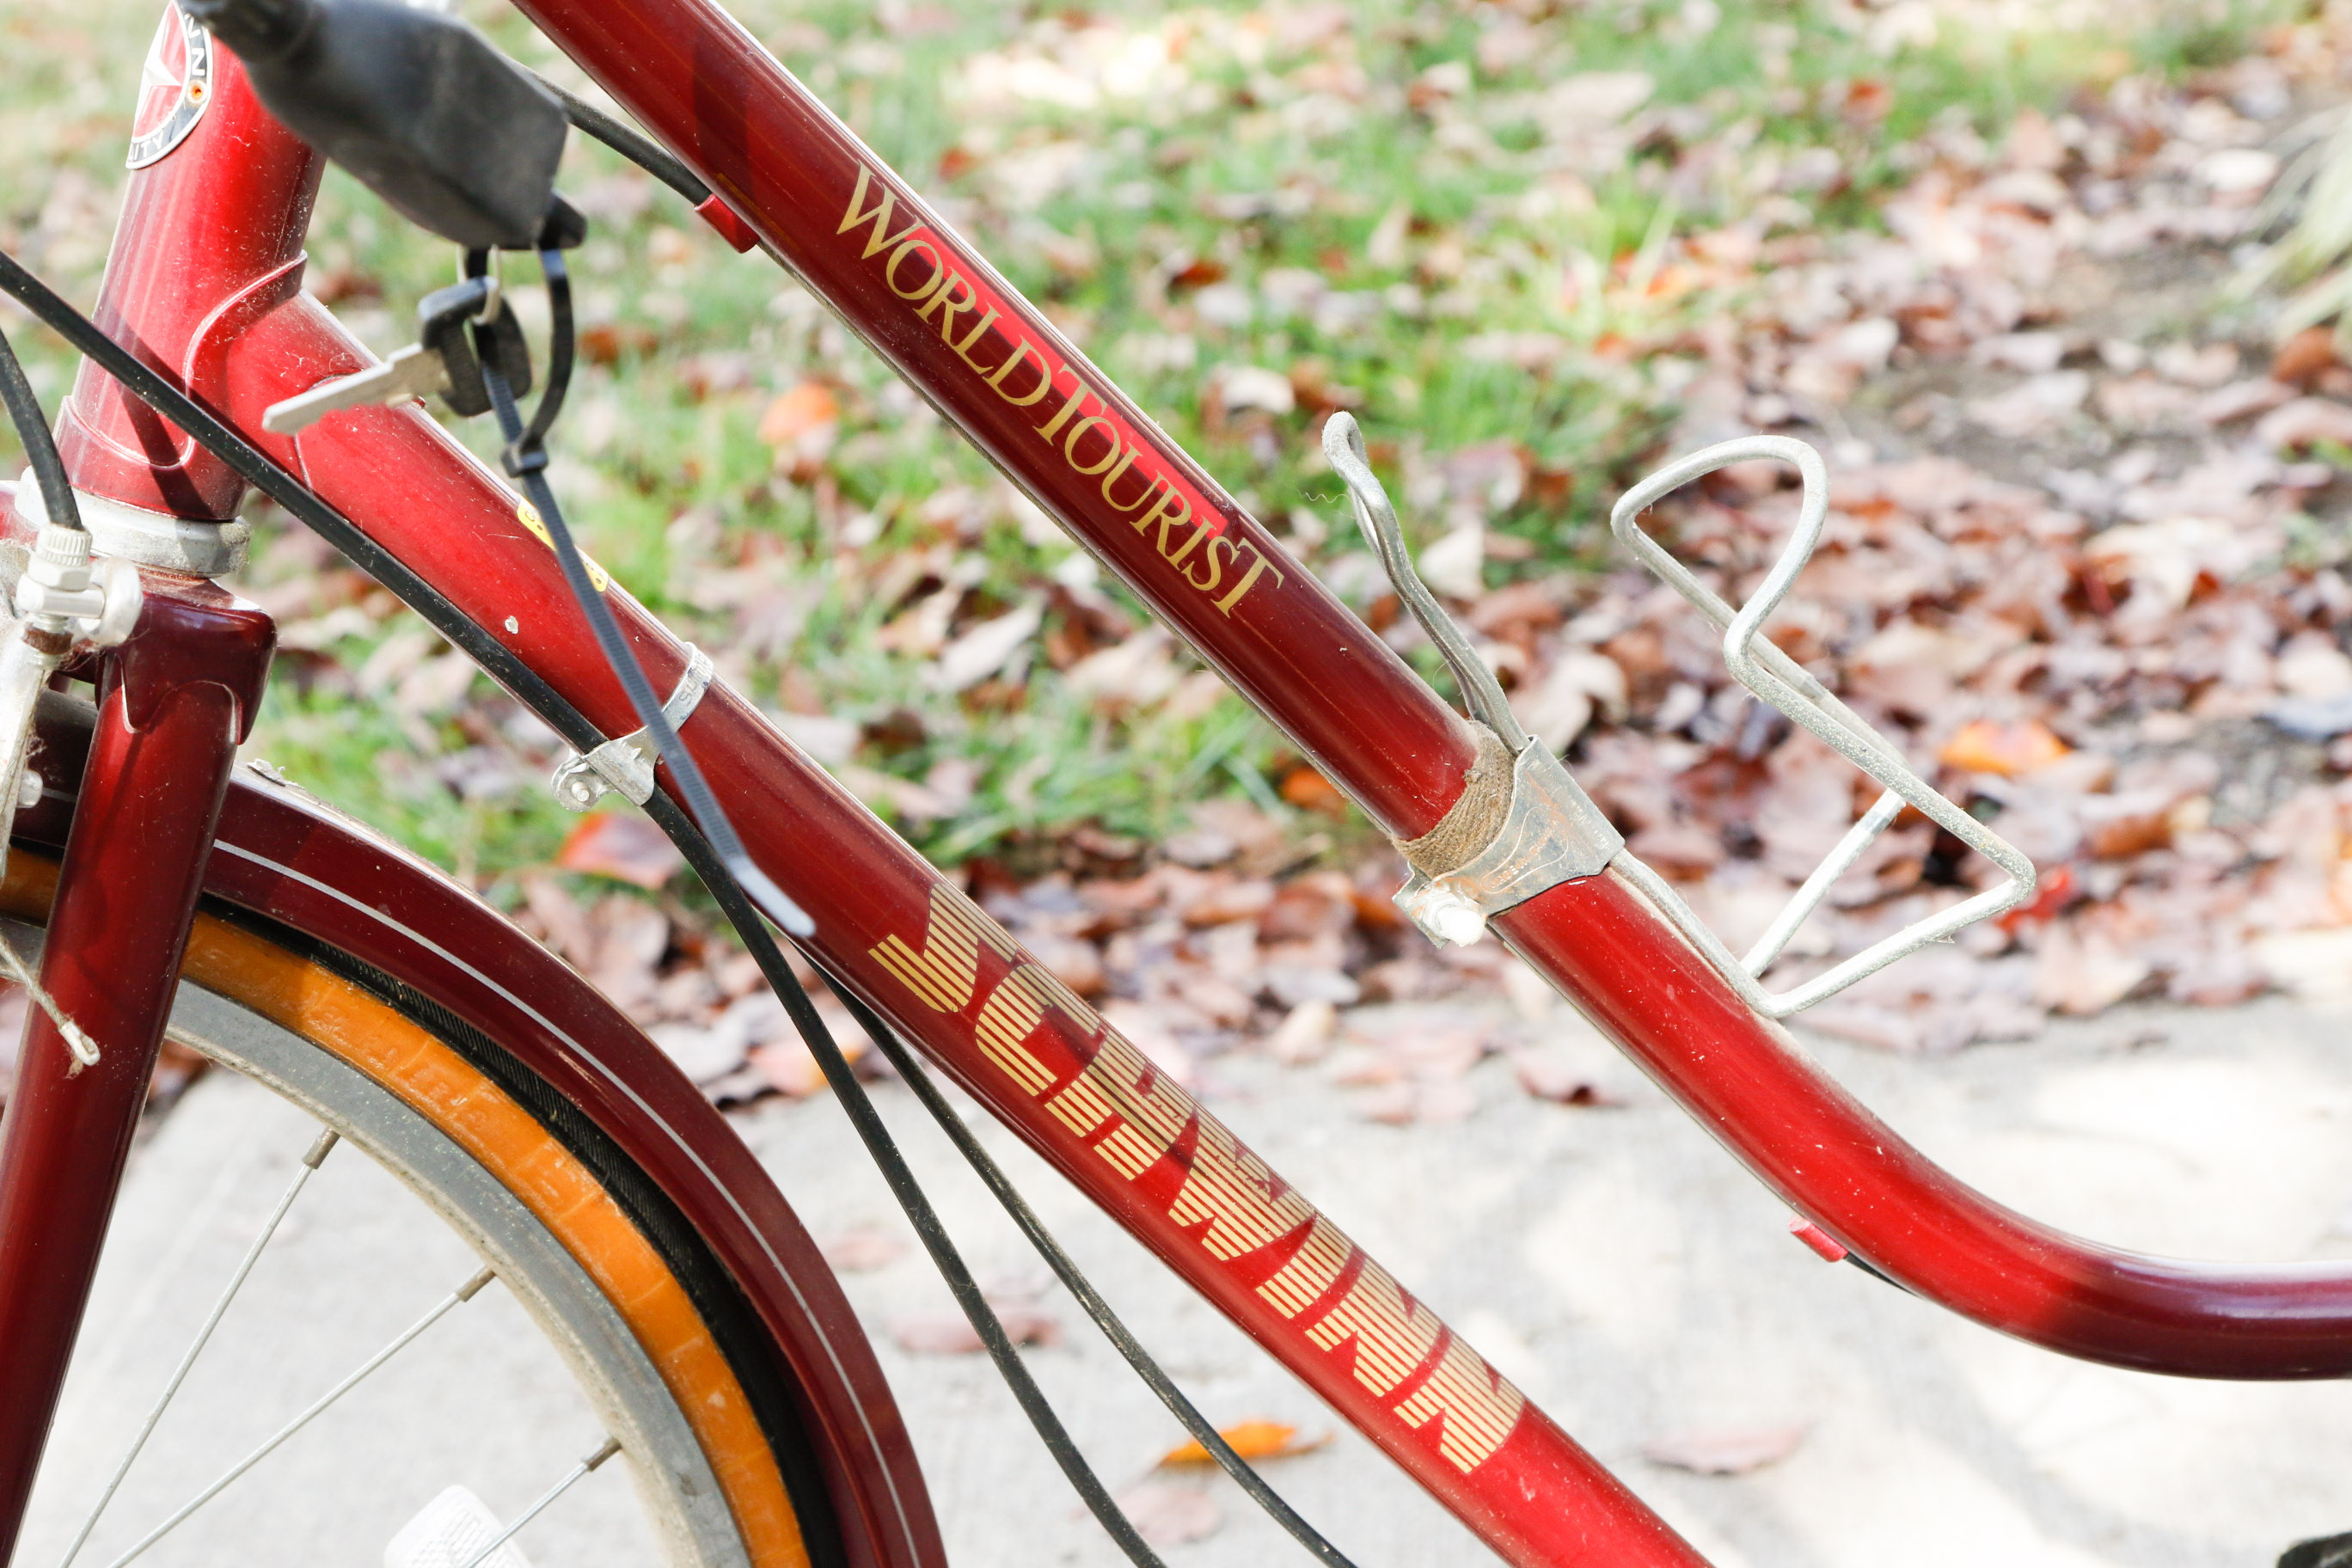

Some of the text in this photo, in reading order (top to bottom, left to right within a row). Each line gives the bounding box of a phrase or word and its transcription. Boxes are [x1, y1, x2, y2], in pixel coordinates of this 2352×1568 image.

[836, 160, 1283, 619] WORLD TOURIST
[868, 883, 1526, 1474] SCHWINN
